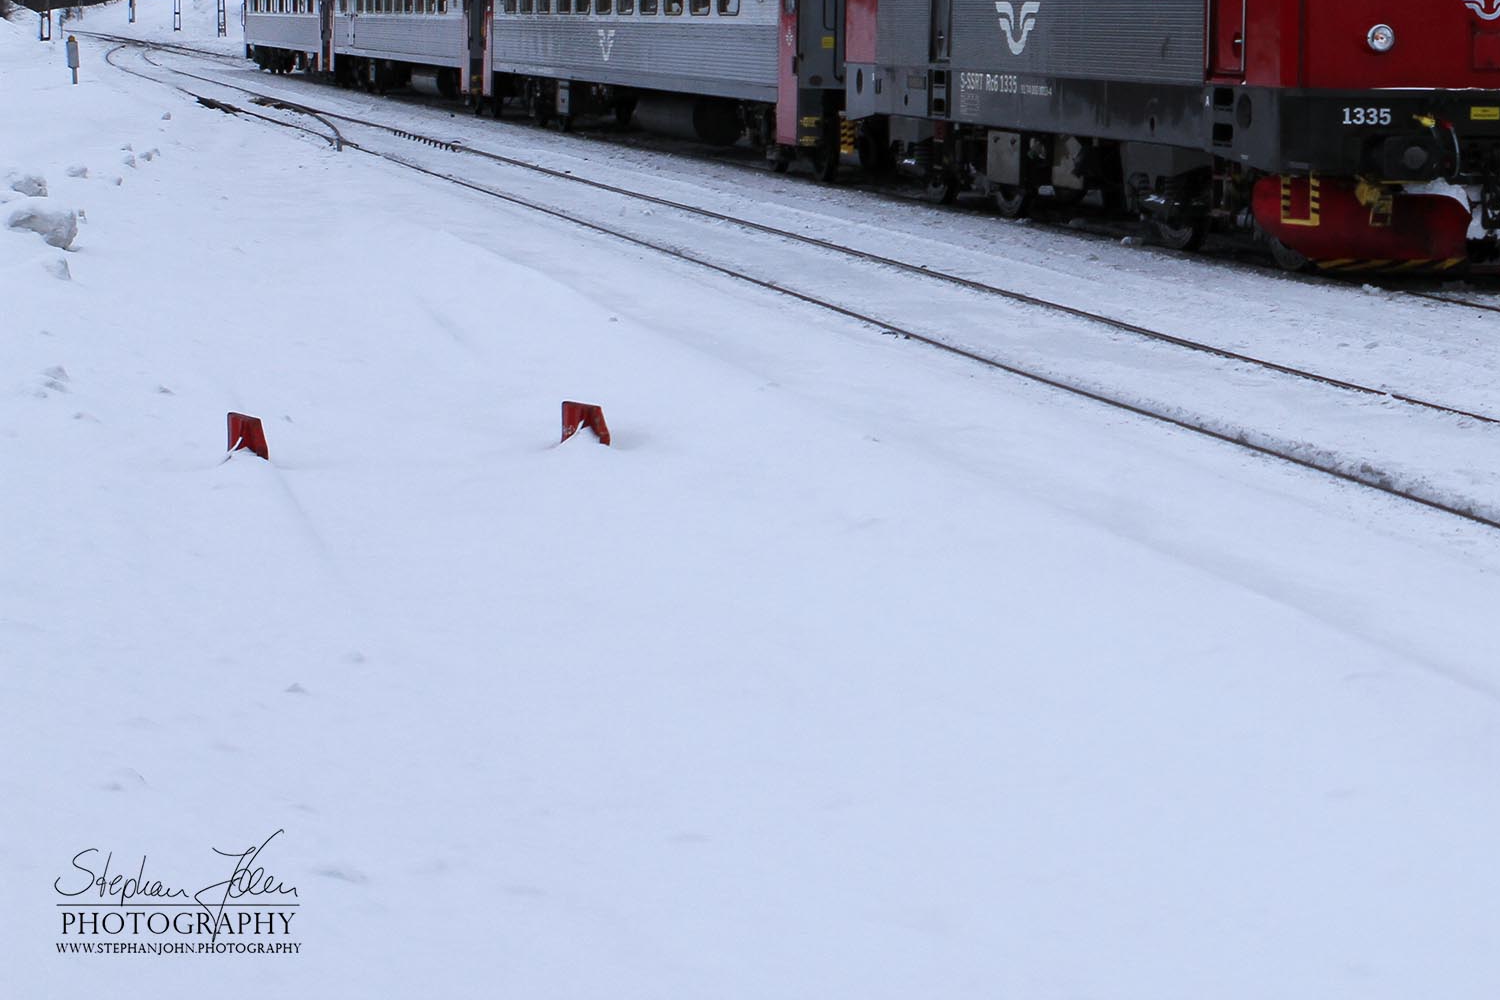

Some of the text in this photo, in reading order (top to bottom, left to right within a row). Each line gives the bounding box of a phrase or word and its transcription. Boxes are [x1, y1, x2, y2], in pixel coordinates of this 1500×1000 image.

[985, 73, 999, 92] Rc6
[1000, 74, 1018, 94] 1335
[1342, 107, 1391, 125] 1335
